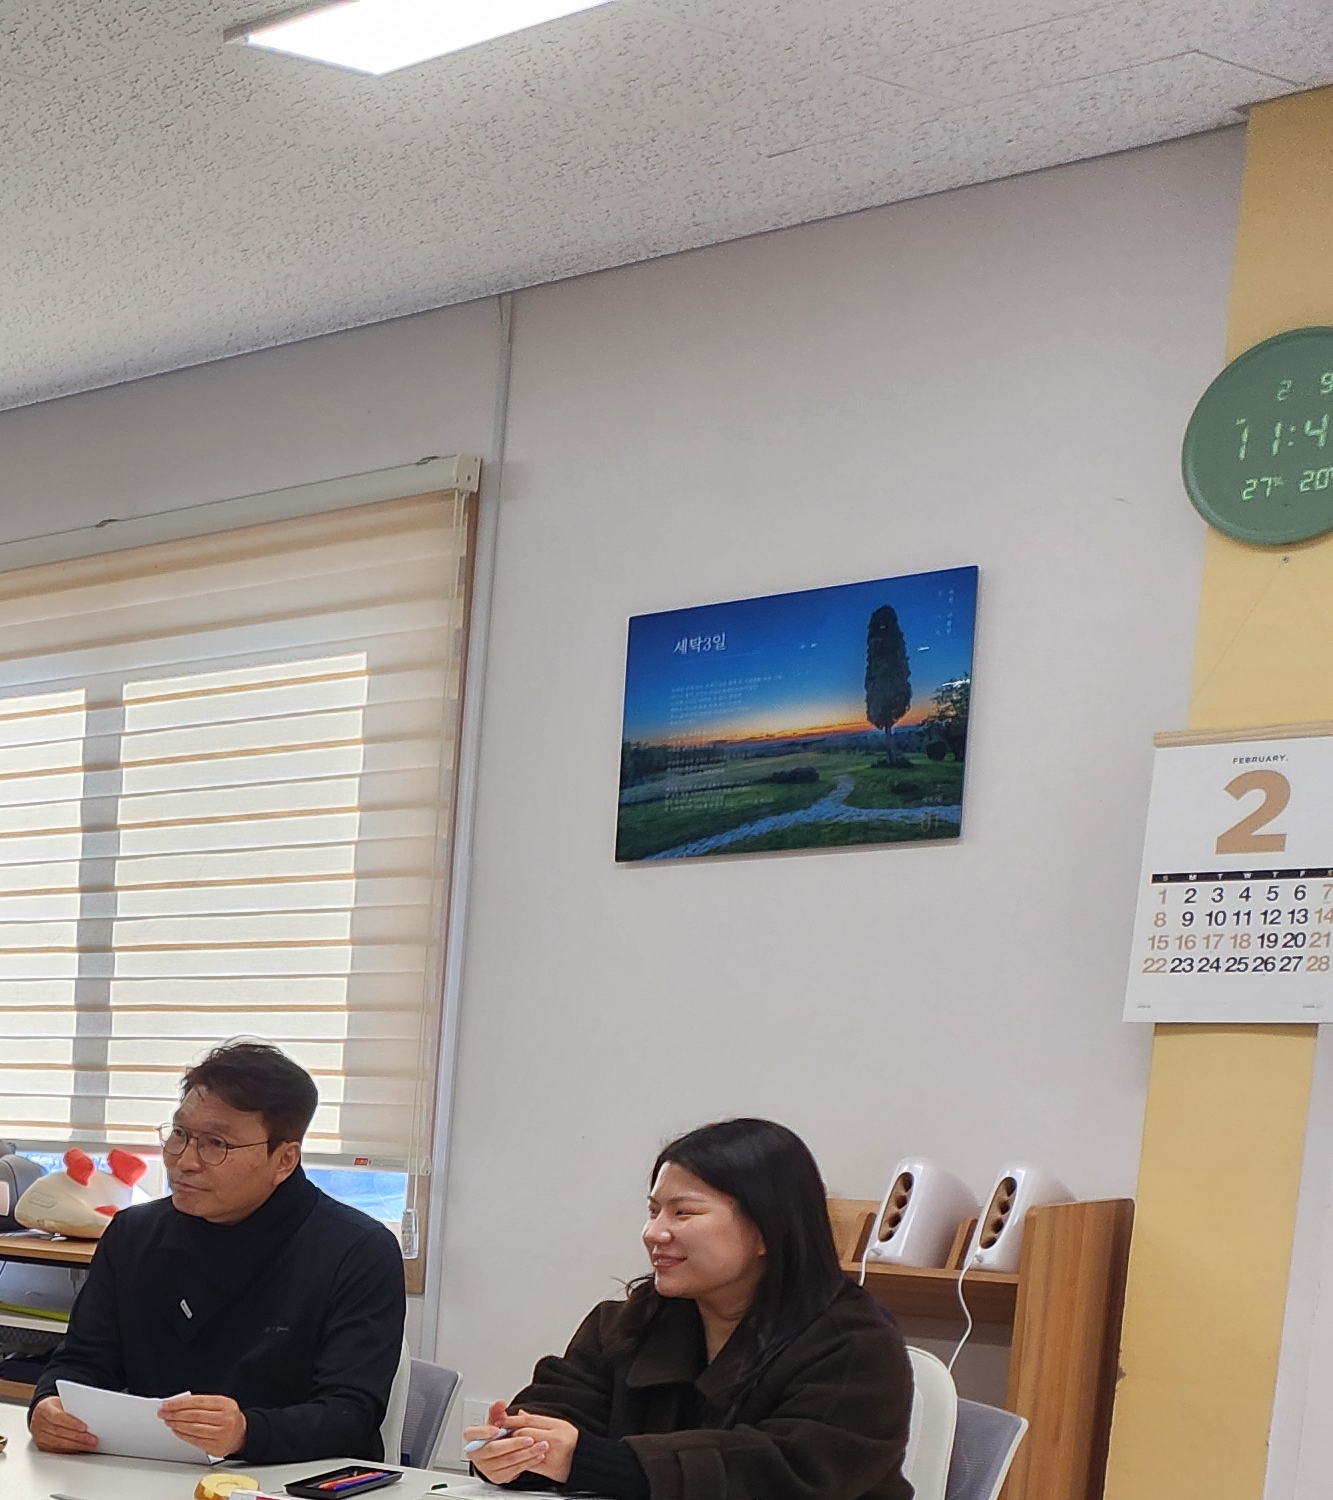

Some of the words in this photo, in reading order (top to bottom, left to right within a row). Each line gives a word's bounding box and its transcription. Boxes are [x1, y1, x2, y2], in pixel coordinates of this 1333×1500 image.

[1277, 380, 1292, 401] 2
[1215, 769, 1291, 855] 2
[1159, 889, 1168, 904] 1
[1184, 887, 1197, 903] 2
[1211, 887, 1224, 902] 3
[1239, 886, 1251, 902] 4
[1266, 886, 1280, 901] 5
[1294, 885, 1306, 900] 6
[1154, 912, 1167, 927] 8
[1181, 911, 1194, 926] 9
[1205, 910, 1226, 926] 10
[1232, 910, 1252, 925] 11
[1260, 909, 1281, 925] 12
[1287, 908, 1308, 924] 13
[1148, 935, 1169, 950] 15
[1175, 934, 1196, 950] 16
[1202, 934, 1224, 949] 17
[1230, 933, 1251, 949] 18
[1257, 932, 1278, 948] 19
[1281, 932, 1306, 948] 20
[1309, 932, 1331, 948] 21
[1142, 957, 1167, 973] 22
[1170, 957, 1194, 973] 23
[1197, 957, 1221, 973] 24
[1225, 956, 1249, 973] 25
[1252, 956, 1276, 972] 26
[1279, 956, 1303, 972] 27
[1306, 955, 1330, 972] 28
